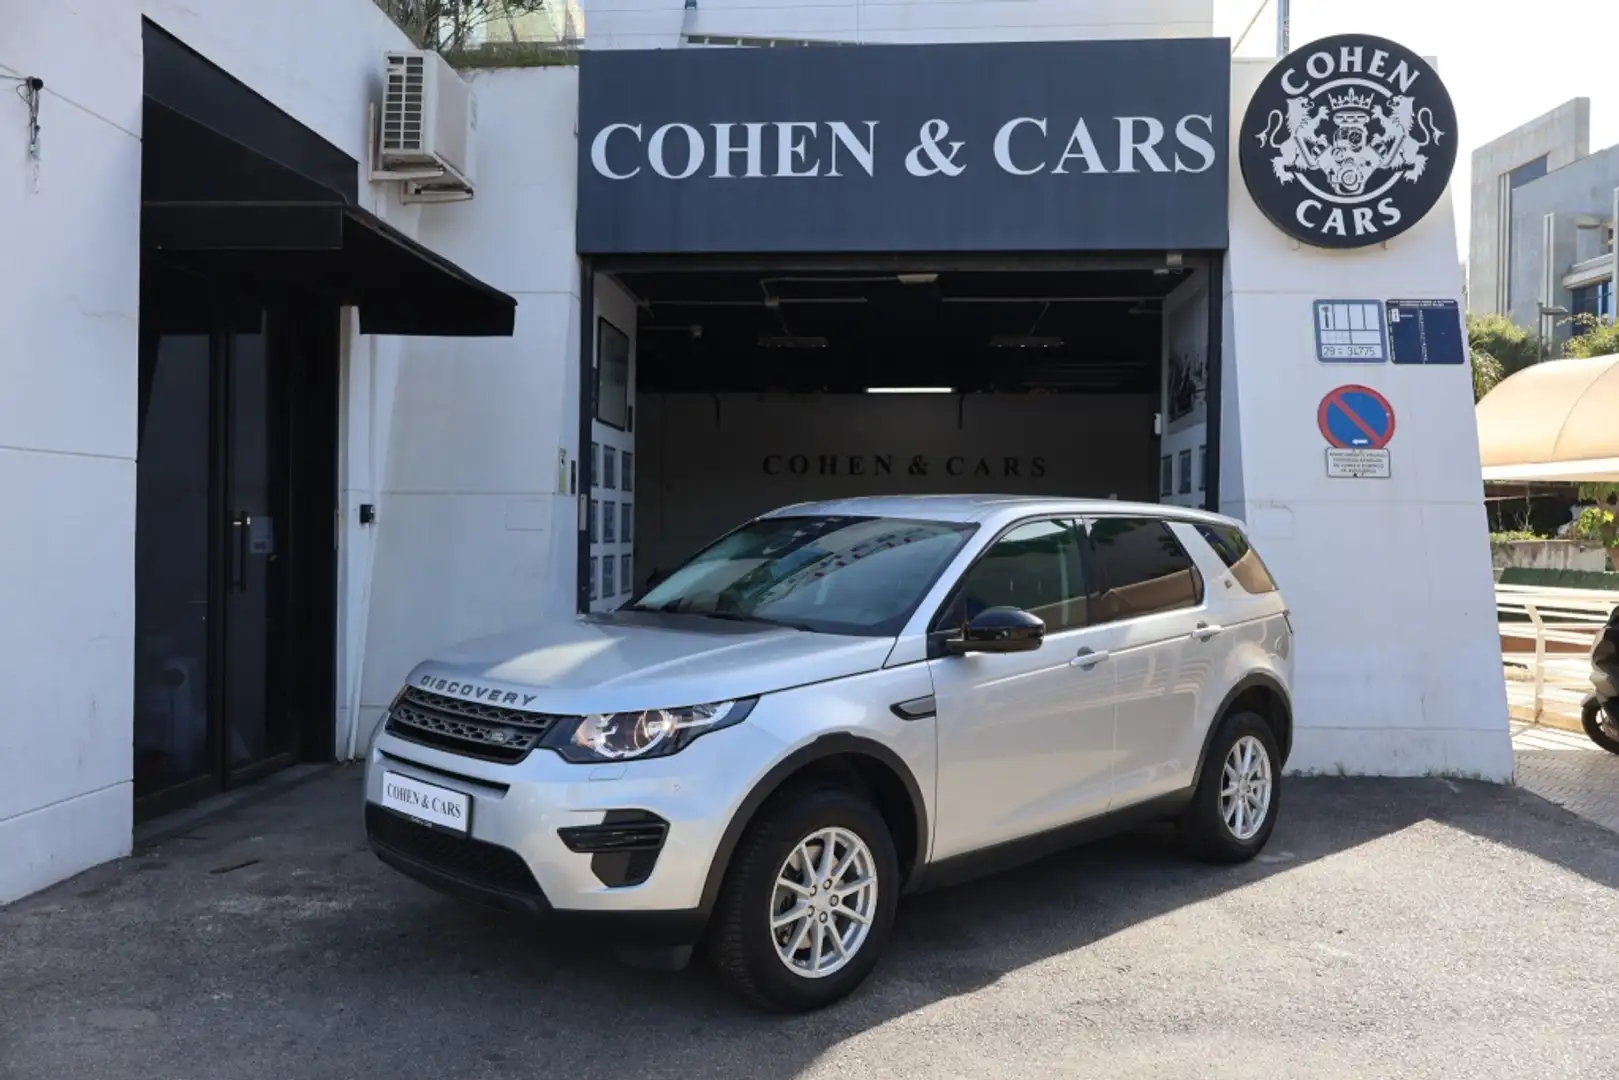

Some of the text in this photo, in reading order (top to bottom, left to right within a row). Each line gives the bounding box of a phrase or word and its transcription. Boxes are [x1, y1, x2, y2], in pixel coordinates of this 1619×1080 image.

[1281, 46, 1421, 95] COHEN
[591, 114, 1215, 180] COHEN & CARS
[1295, 197, 1402, 237] CARS
[762, 454, 1047, 478] COHEN & CARS
[420, 675, 537, 706] DISCOVERY
[387, 783, 462, 819] COHEN & CARS
